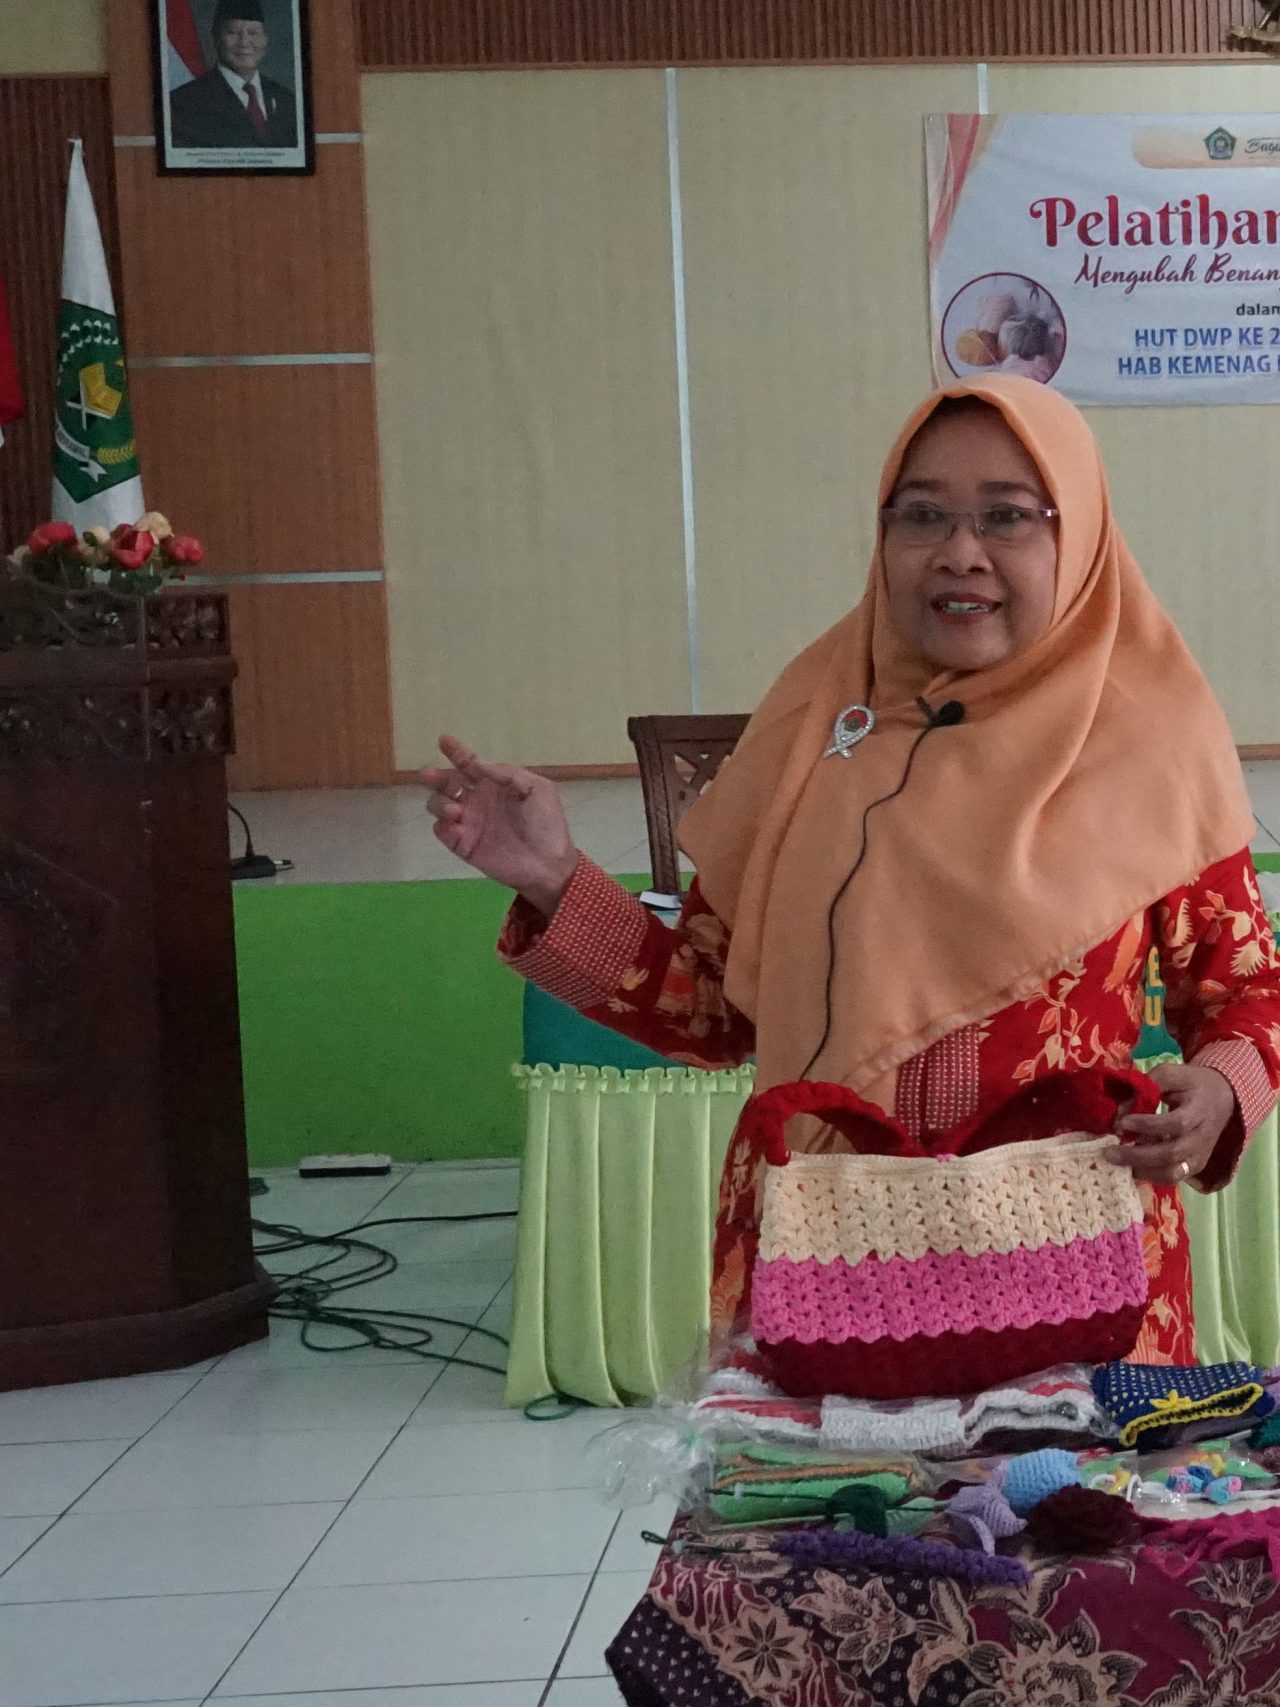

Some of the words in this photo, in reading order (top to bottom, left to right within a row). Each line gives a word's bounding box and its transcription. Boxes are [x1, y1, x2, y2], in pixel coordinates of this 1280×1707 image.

[1074, 252, 1198, 294] Mengubah
[1135, 328, 1178, 347] HUT
[1184, 327, 1232, 346] DWP
[1238, 327, 1263, 346] KE
[1118, 356, 1161, 375] HAB
[1168, 354, 1271, 374] KEMENAG
